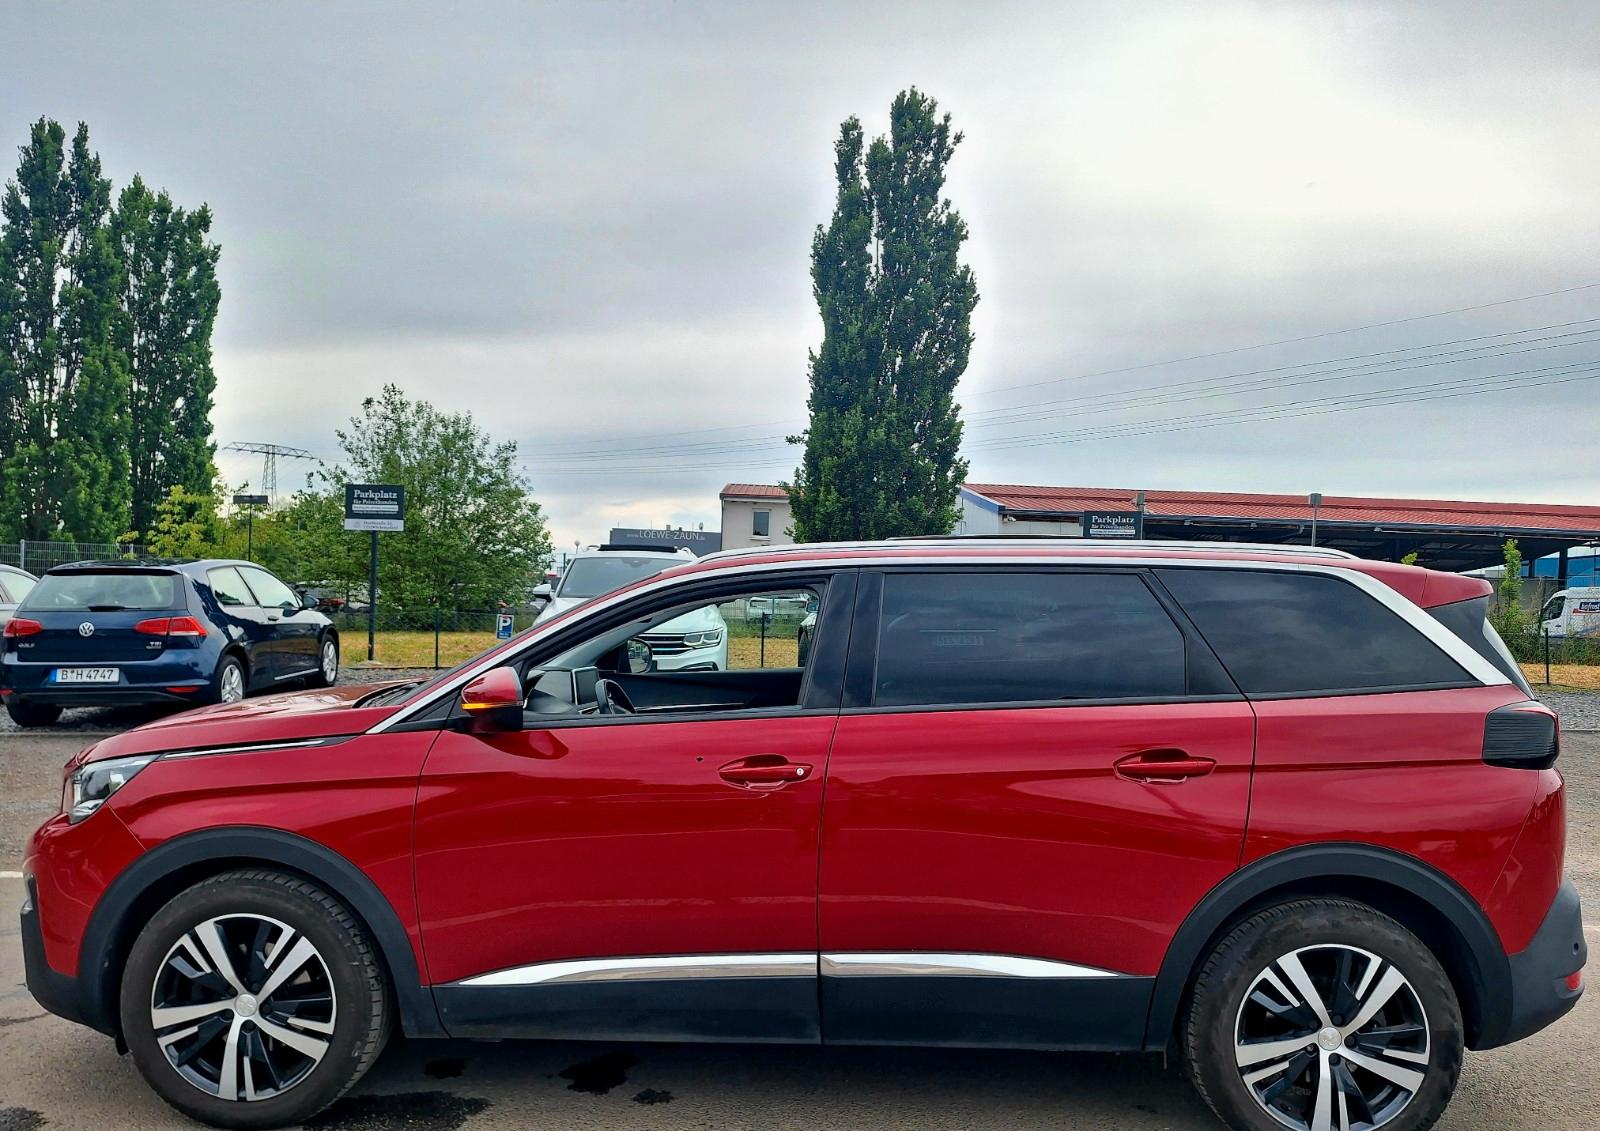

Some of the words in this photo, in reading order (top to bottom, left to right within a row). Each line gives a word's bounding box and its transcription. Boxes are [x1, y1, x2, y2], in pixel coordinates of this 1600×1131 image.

[353, 489, 398, 500] Parkplatz
[1091, 515, 1135, 525] Parkplatz
[499, 616, 511, 631] P
